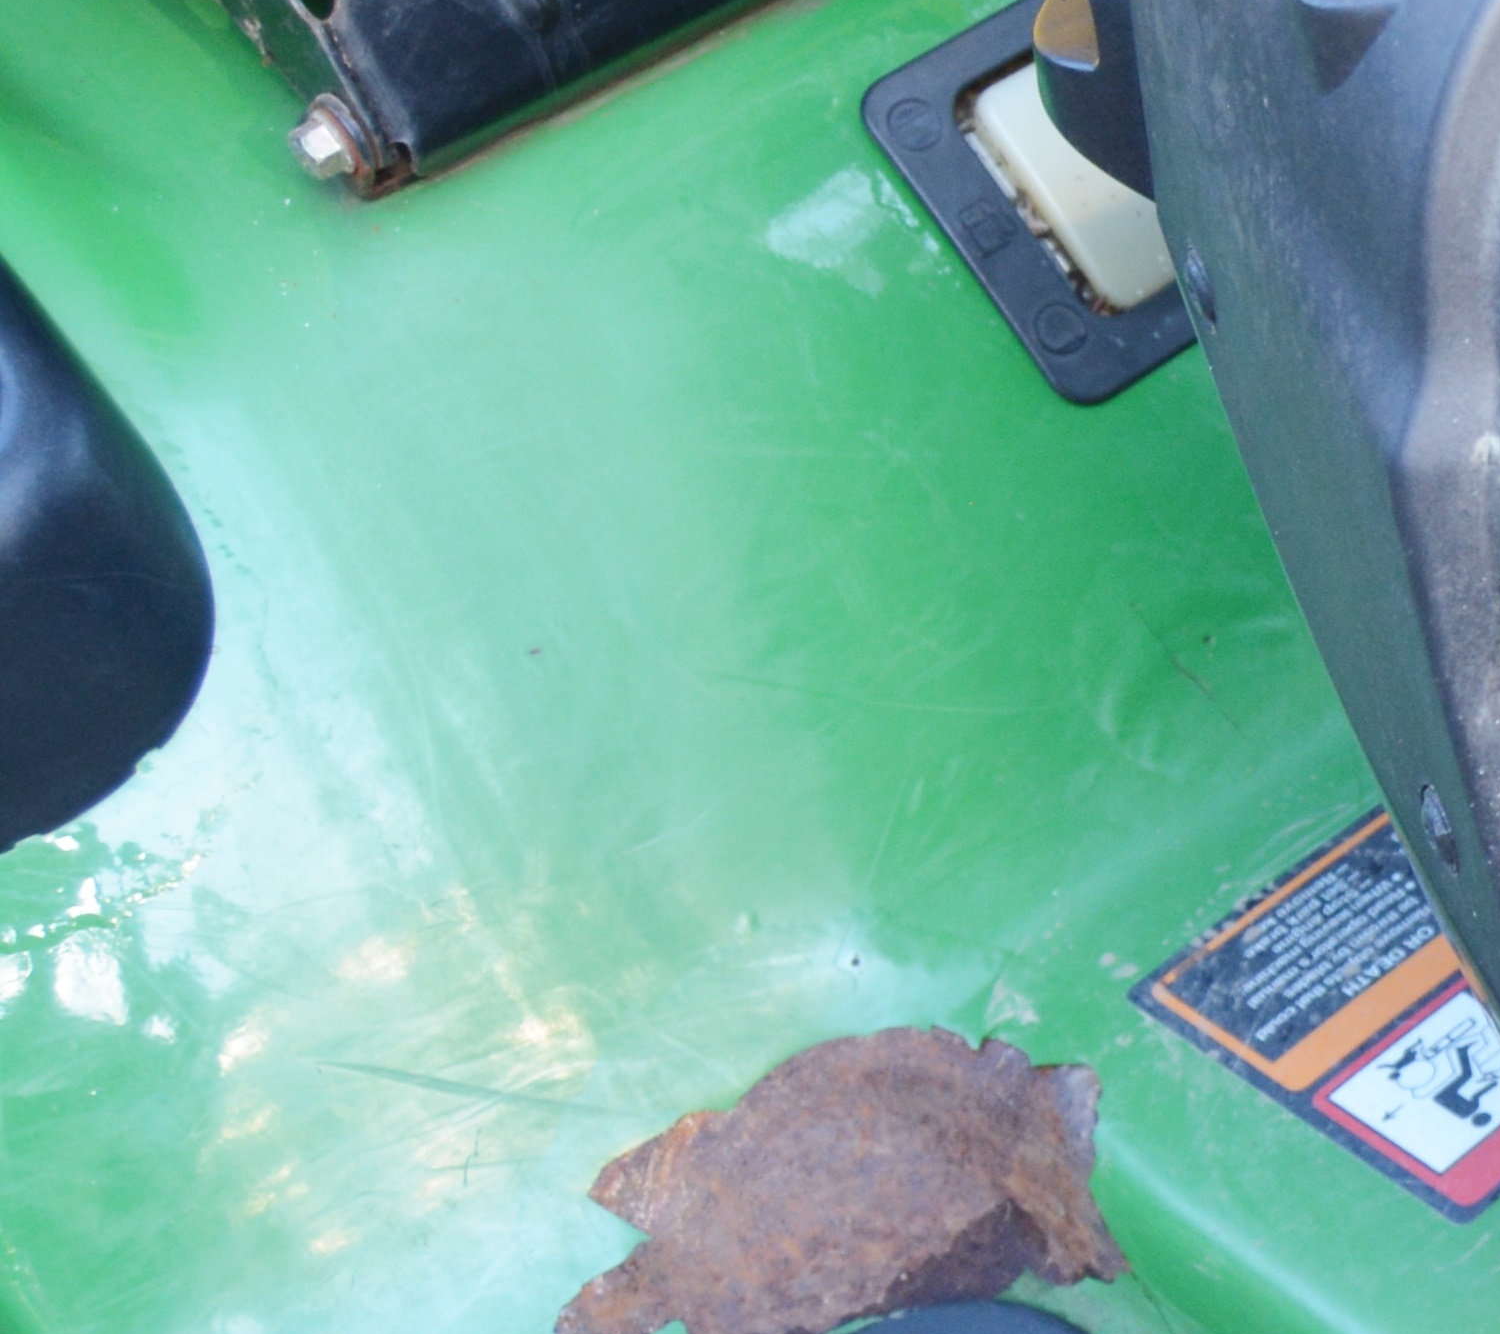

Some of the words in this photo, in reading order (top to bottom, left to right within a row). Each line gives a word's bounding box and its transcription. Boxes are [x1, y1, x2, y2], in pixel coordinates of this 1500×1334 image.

[1402, 923, 1436, 950] OR
[1238, 944, 1304, 995] machine
[1244, 964, 1301, 1009] manual
[1280, 959, 1333, 1000] blades
[1339, 945, 1406, 998] DEATH
[1294, 983, 1328, 1010] that
[1252, 1004, 1300, 1042] could
